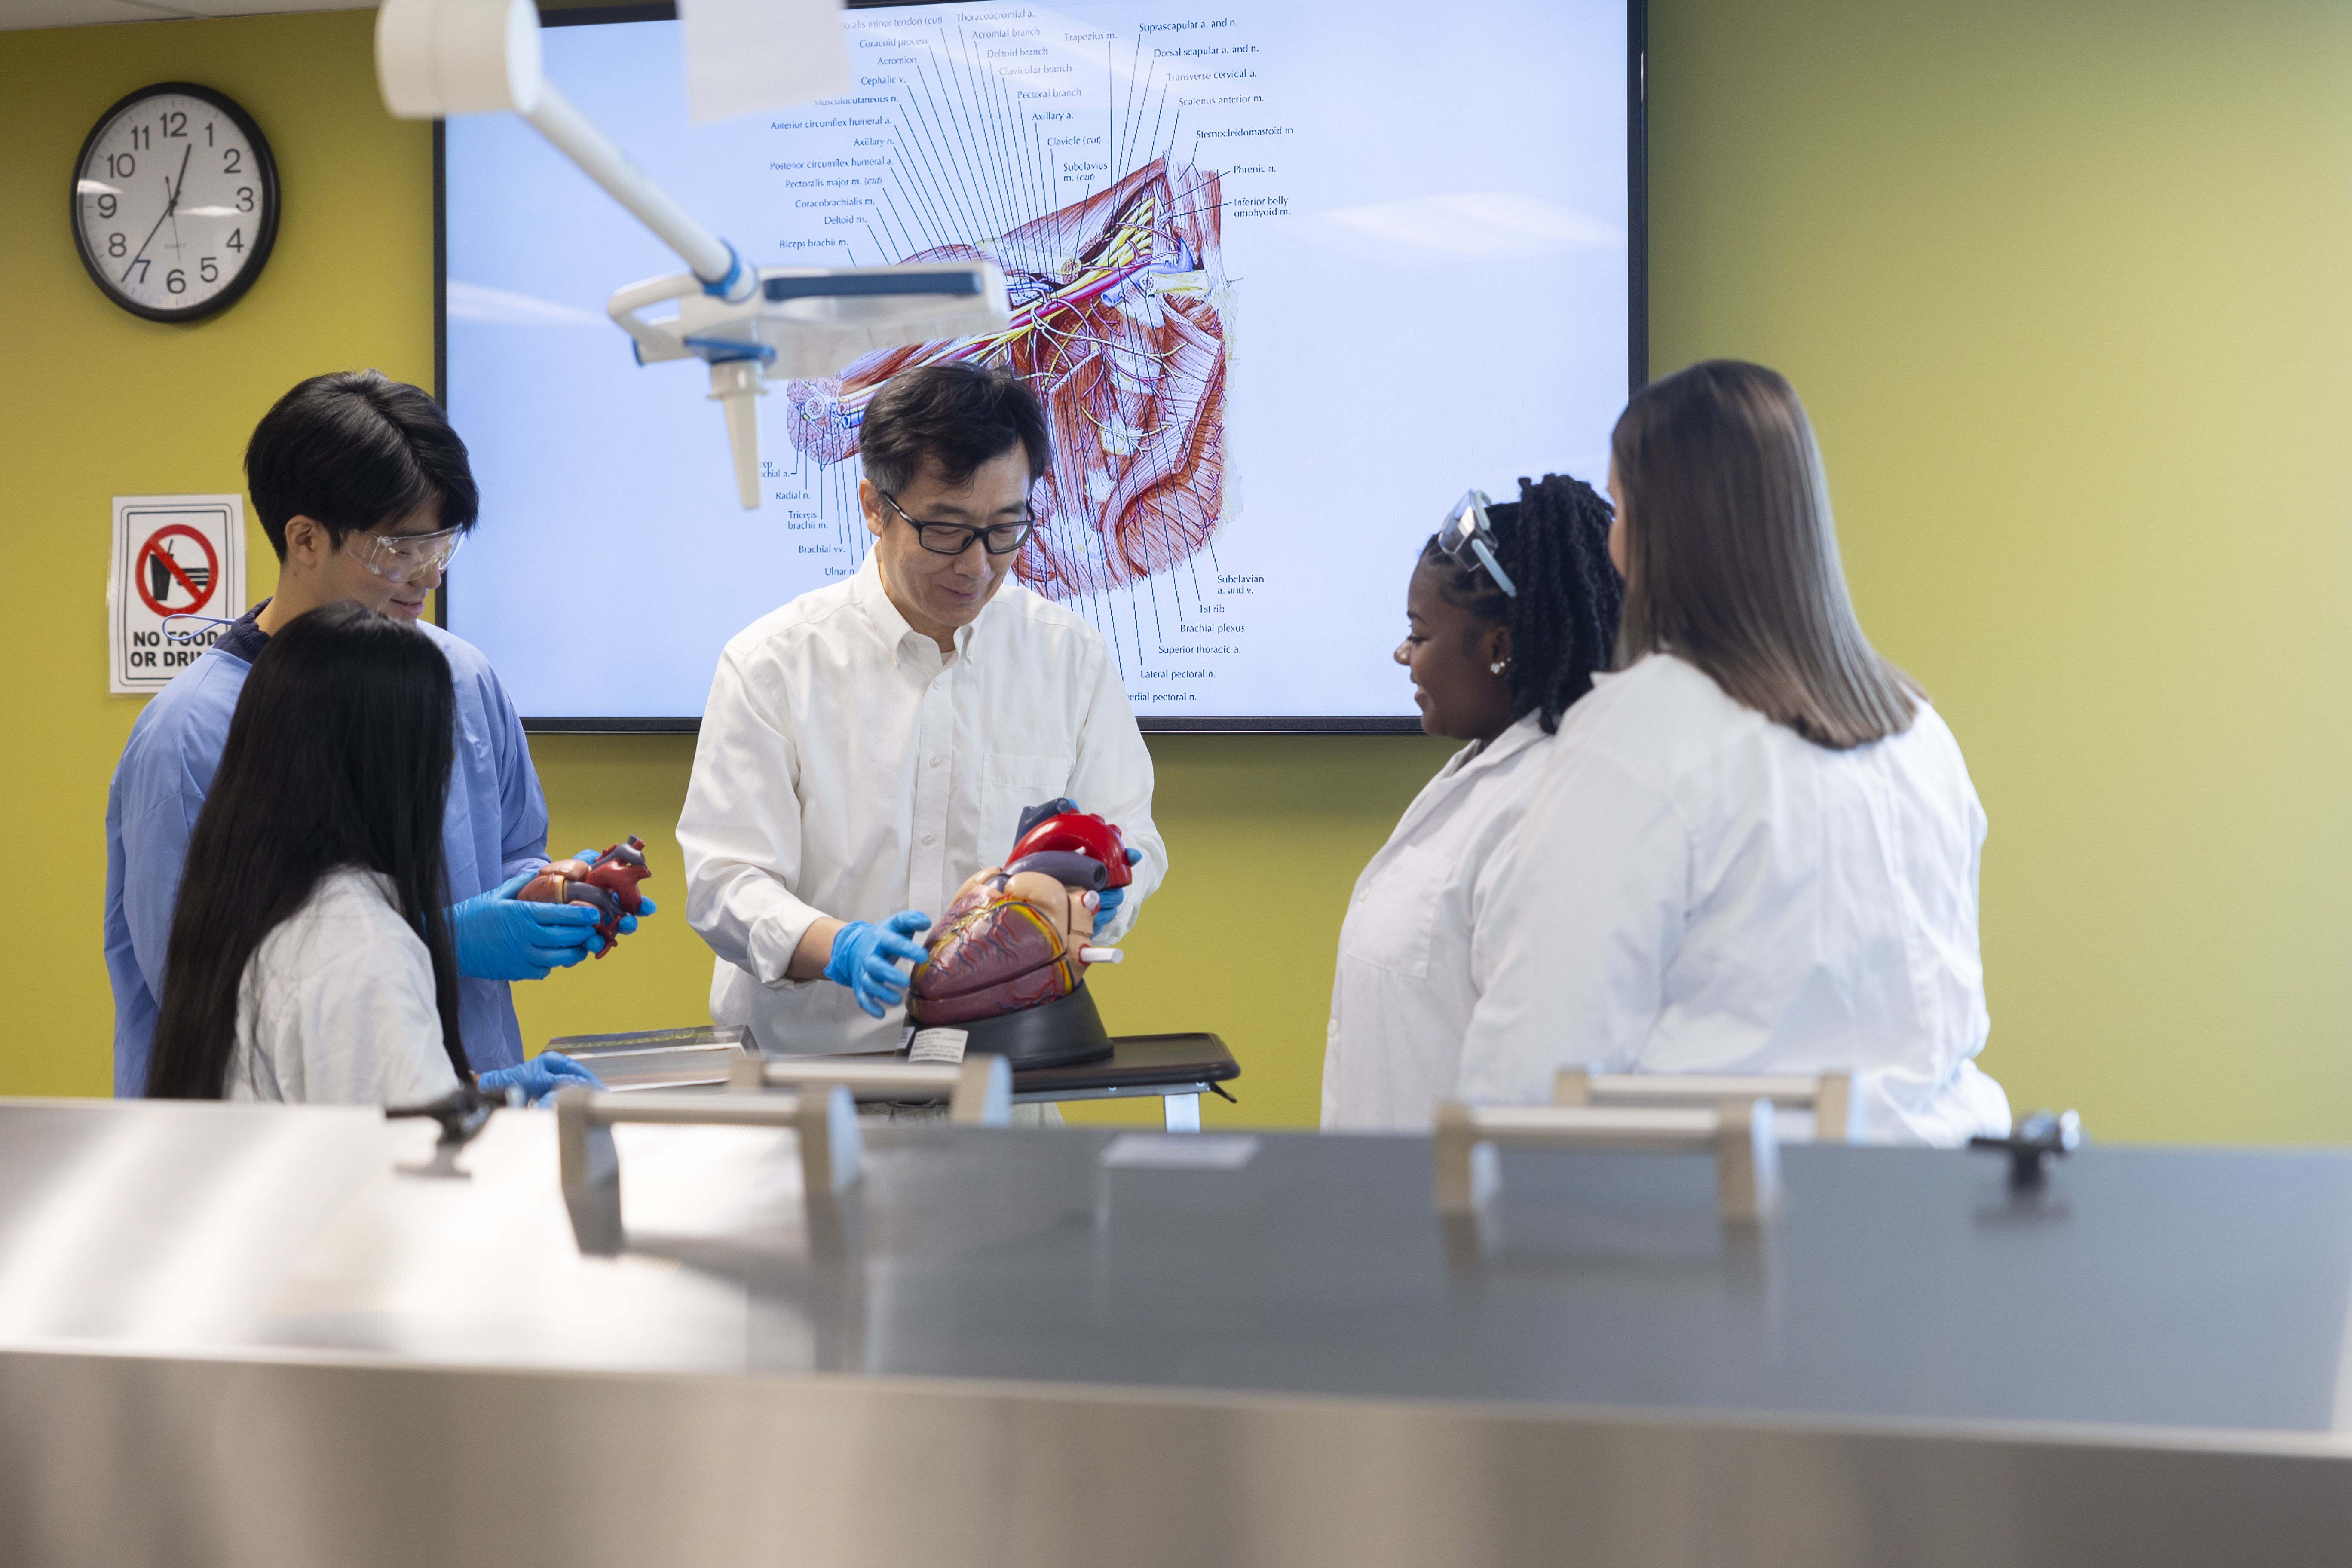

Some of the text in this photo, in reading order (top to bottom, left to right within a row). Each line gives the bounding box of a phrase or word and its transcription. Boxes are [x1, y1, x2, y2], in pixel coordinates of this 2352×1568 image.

[842, 19, 866, 30] toralis
[868, 18, 893, 28] minor
[894, 16, 922, 27] tendon
[1139, 20, 1198, 34] Suprascapular
[1211, 18, 1227, 28] and
[971, 26, 1040, 39] Acromial branch
[1064, 31, 1104, 43] Trapezius
[1020, 46, 1048, 56] branch
[1154, 47, 1181, 57] Dorsal
[1183, 46, 1219, 58] scapular
[1232, 44, 1248, 53] and
[998, 63, 1072, 76] Clavicular branch
[1167, 73, 1211, 81] Transverse
[1214, 68, 1246, 79] cervical
[861, 75, 896, 87] Cephalic
[1017, 87, 1081, 99] Pectoral branch
[1179, 97, 1216, 106] Scalenus
[1218, 94, 1251, 104] anterior
[1032, 111, 1064, 121] Axillary
[159, 111, 188, 138] 12
[771, 120, 802, 130] Anterior
[849, 115, 882, 126] humeral
[130, 125, 150, 151] 11
[205, 121, 214, 147] 1
[854, 137, 885, 147] Axillary
[1047, 136, 1081, 147] Clavicle
[105, 152, 135, 179] 10
[223, 148, 242, 174] 2
[770, 162, 804, 170] Posterior
[851, 156, 885, 167] humeral
[1063, 161, 1108, 172] Subclavius
[1234, 164, 1265, 174] Phrenic
[786, 178, 824, 188] Pectoralis
[826, 178, 849, 188] major
[235, 186, 254, 213] 3
[795, 197, 863, 208] Coracobrachialis
[1234, 196, 1289, 206] Inferior belly
[97, 193, 118, 220] 9
[824, 214, 854, 224] Deltoid
[108, 232, 127, 258] 8
[226, 227, 245, 254] 4
[780, 240, 806, 251] Biceps
[808, 238, 835, 247] brachii
[135, 259, 152, 285] 7
[200, 256, 219, 283] 5
[166, 269, 186, 295] 6
[760, 461, 772, 472] eep
[776, 490, 801, 500] Radial
[788, 521, 815, 530] brachii
[799, 544, 831, 554] Brachial
[825, 566, 846, 576] Ulnar
[1217, 574, 1264, 583] Subclavian
[1228, 585, 1244, 594] and
[1213, 604, 1225, 613] rib
[1180, 623, 1244, 635] Brachial plexus
[133, 631, 160, 647] NO
[1158, 645, 1194, 656] Superior
[1197, 644, 1230, 654] thoracic
[130, 651, 204, 667] OR DRI
[1140, 669, 1168, 679] Lateral
[1171, 669, 1205, 681] pectoral
[1153, 692, 1186, 703] pectoral
